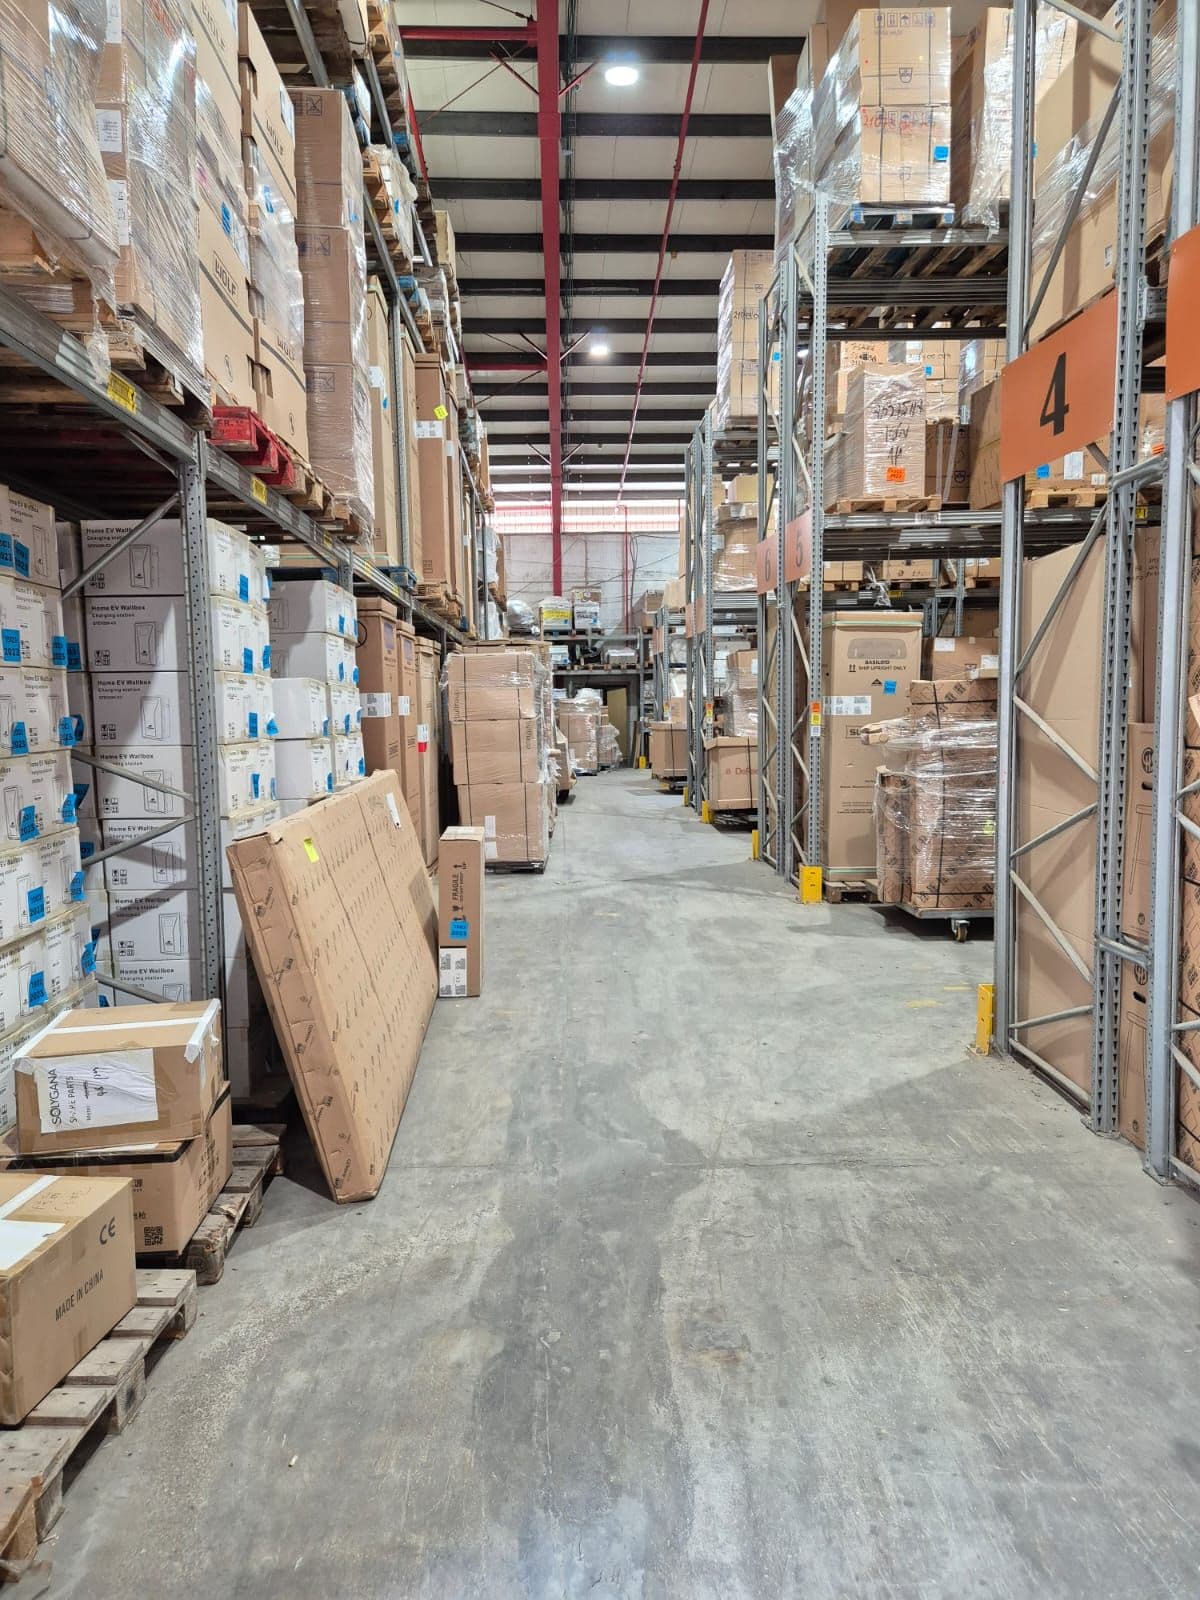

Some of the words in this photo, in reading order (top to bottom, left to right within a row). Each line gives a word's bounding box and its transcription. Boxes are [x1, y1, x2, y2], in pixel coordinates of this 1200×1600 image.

[215, 258, 237, 296] WOLF
[1040, 352, 1069, 436] 4
[452, 874, 460, 901] FRAGILE
[47, 1068, 62, 1125] SOLYGANA
[65, 1075, 76, 1098] PARTS
[98, 1216, 116, 1246] CE
[55, 1294, 75, 1322] MADE
[76, 1286, 84, 1303] IN
[84, 1267, 104, 1295] CHINA
